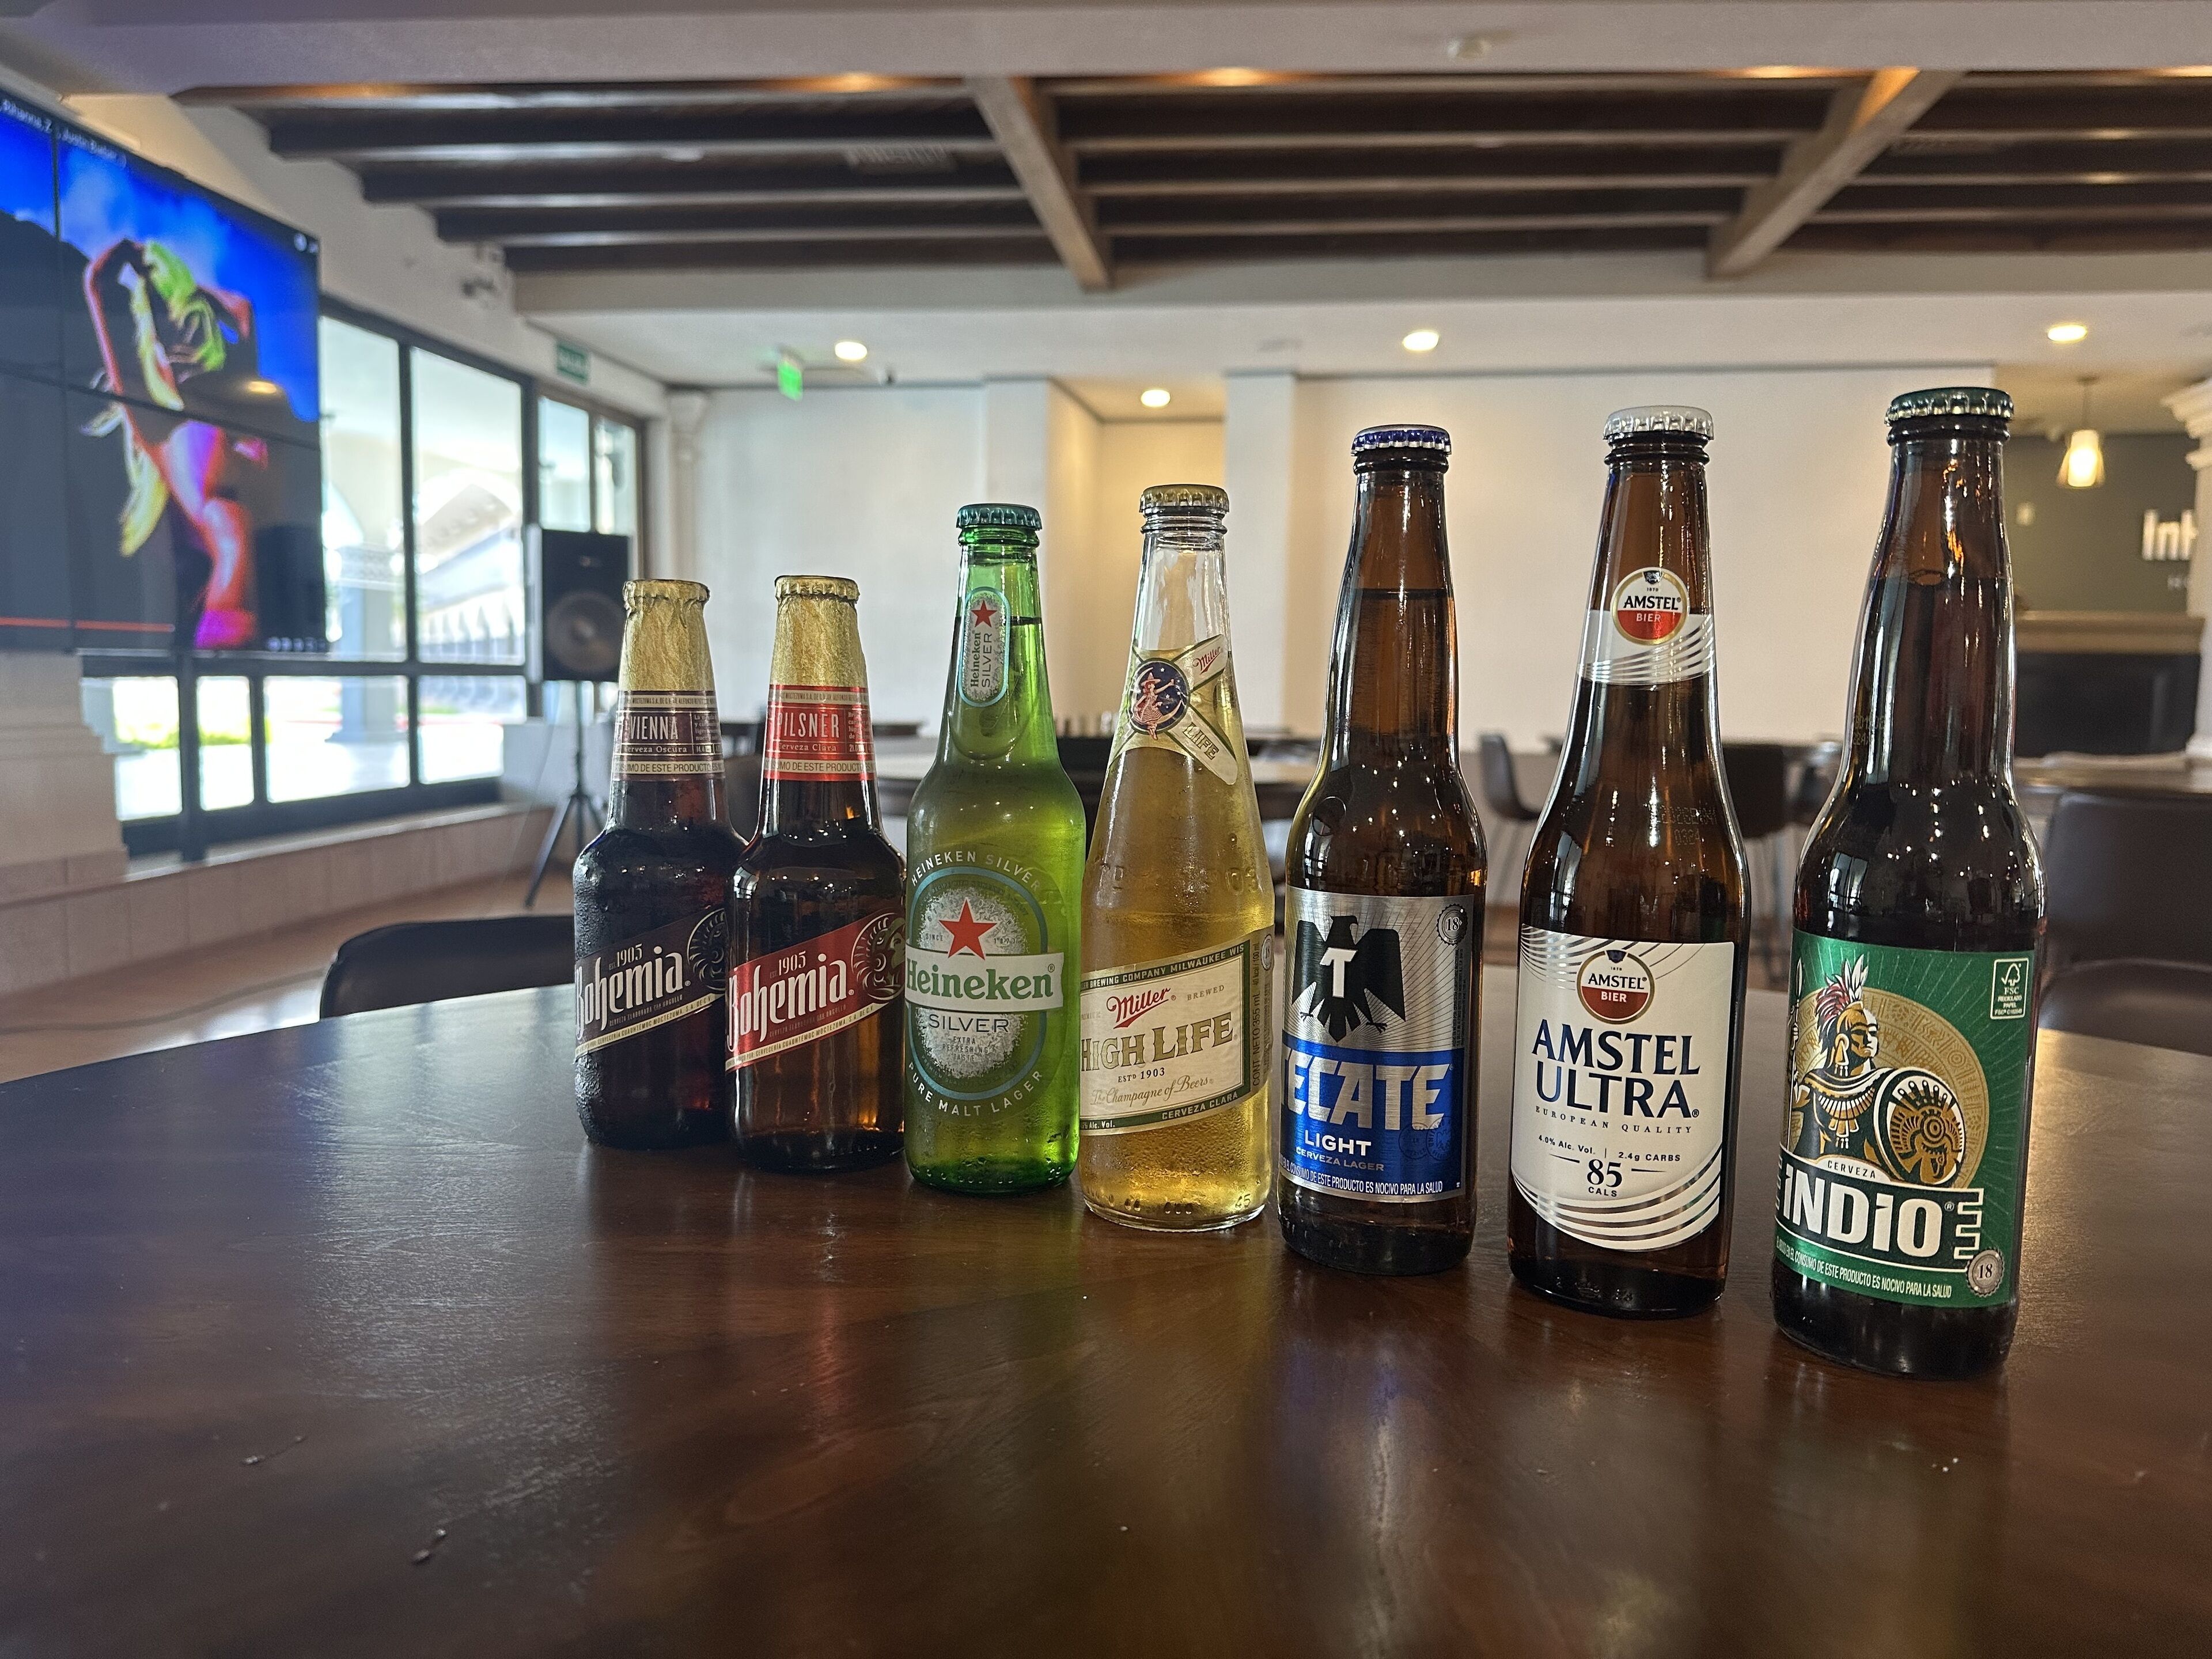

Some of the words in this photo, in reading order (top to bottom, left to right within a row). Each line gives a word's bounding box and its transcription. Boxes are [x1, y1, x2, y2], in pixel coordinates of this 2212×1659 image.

[1623, 594, 1679, 611] AMSTEL
[1636, 612, 1662, 623] BIER
[970, 632, 981, 688] Heineken
[982, 633, 993, 688] SILVER
[1192, 646, 1221, 675] Miller
[630, 715, 679, 740] VIENNA
[778, 712, 839, 737] PILSNER
[812, 744, 836, 752] Clara
[1183, 721, 1219, 760] LIFE
[640, 764, 650, 772] DE
[652, 764, 672, 772] ESTE
[792, 762, 802, 771] DE
[804, 762, 823, 771] ESTE
[911, 851, 977, 887] HEINEKEN
[985, 854, 1041, 892] SILVER
[617, 943, 643, 968] 1905
[778, 950, 806, 976] 1905
[907, 957, 1054, 1001] Heineken
[1090, 975, 1119, 988] BREWING
[1123, 967, 1166, 982] COMPANY
[1170, 951, 1227, 972] MILWAUKEE
[1319, 946, 1357, 999] T
[1588, 972, 1645, 990] AMSTEL
[576, 946, 684, 1040] Bohemia
[726, 953, 847, 1052] Bohemia
[1187, 984, 1225, 1001] BREWED
[1600, 991, 1627, 1003] BIER
[2004, 986, 2020, 995] FSC
[1106, 987, 1172, 1029] Miller
[1252, 1008, 1260, 1027] 355
[928, 1013, 1010, 1033] SILVER
[942, 1043, 989, 1055] REFRESHING
[953, 1036, 976, 1044] EXTRA
[1081, 1033, 1146, 1072] HIGH
[1152, 1011, 1233, 1062] LIFE
[1531, 1018, 1701, 1075] AMSTEL
[953, 1054, 975, 1062] TASTE
[1140, 1067, 1166, 1080] 1903
[908, 1062, 934, 1103] PURE
[938, 1099, 982, 1117] MALT
[990, 1070, 1043, 1113] LAGER
[1105, 1086, 1162, 1107] Champagne
[1164, 1078, 1177, 1101] of
[1173, 1074, 1209, 1093] Beers
[1536, 1060, 1692, 1119] ULTRA
[1162, 1103, 1206, 1120] CERVEZA
[1209, 1090, 1238, 1109] CLARA
[1101, 1119, 1116, 1128] Vol.
[1535, 1105, 1609, 1129] EUROPEAN
[1621, 1123, 1692, 1134] QUALITY
[1304, 1129, 1372, 1157] LIGHT
[1538, 1134, 1556, 1146] 4.0%
[1558, 1140, 1575, 1151] Alc.
[1578, 1145, 1596, 1155] Vol.
[1296, 1146, 1341, 1166] CERVEZA
[1343, 1159, 1385, 1172] LAGER
[1618, 1152, 1641, 1162] 2.4g
[1645, 1153, 1681, 1162] CARBS
[1310, 1170, 1317, 1183] DE
[1317, 1172, 1331, 1187] ESTE
[1332, 1175, 1365, 1193] PRODUCTO
[1365, 1180, 1374, 1194] ES
[1374, 1181, 1399, 1195] NOCIVO
[1400, 1183, 1416, 1195] PARA
[1416, 1182, 1425, 1195] LA
[1425, 1180, 1443, 1194] SALUD
[1586, 1158, 1623, 1188] 85
[1827, 1160, 1877, 1180] CERVEZA
[1588, 1186, 1618, 1198] CALS
[1795, 1250, 1817, 1271] CONSUMO
[1817, 1260, 1825, 1274] DE
[1824, 1262, 1840, 1279] ESTE
[1839, 1267, 1872, 1287] PRODUCTO
[1872, 1274, 1881, 1290] ES
[1881, 1277, 1906, 1294] NOCIVO
[1905, 1280, 1923, 1297] PARA
[1922, 1283, 1932, 1297] LA
[1931, 1283, 1953, 1299] SALUD
[1977, 1262, 1993, 1279] 18
